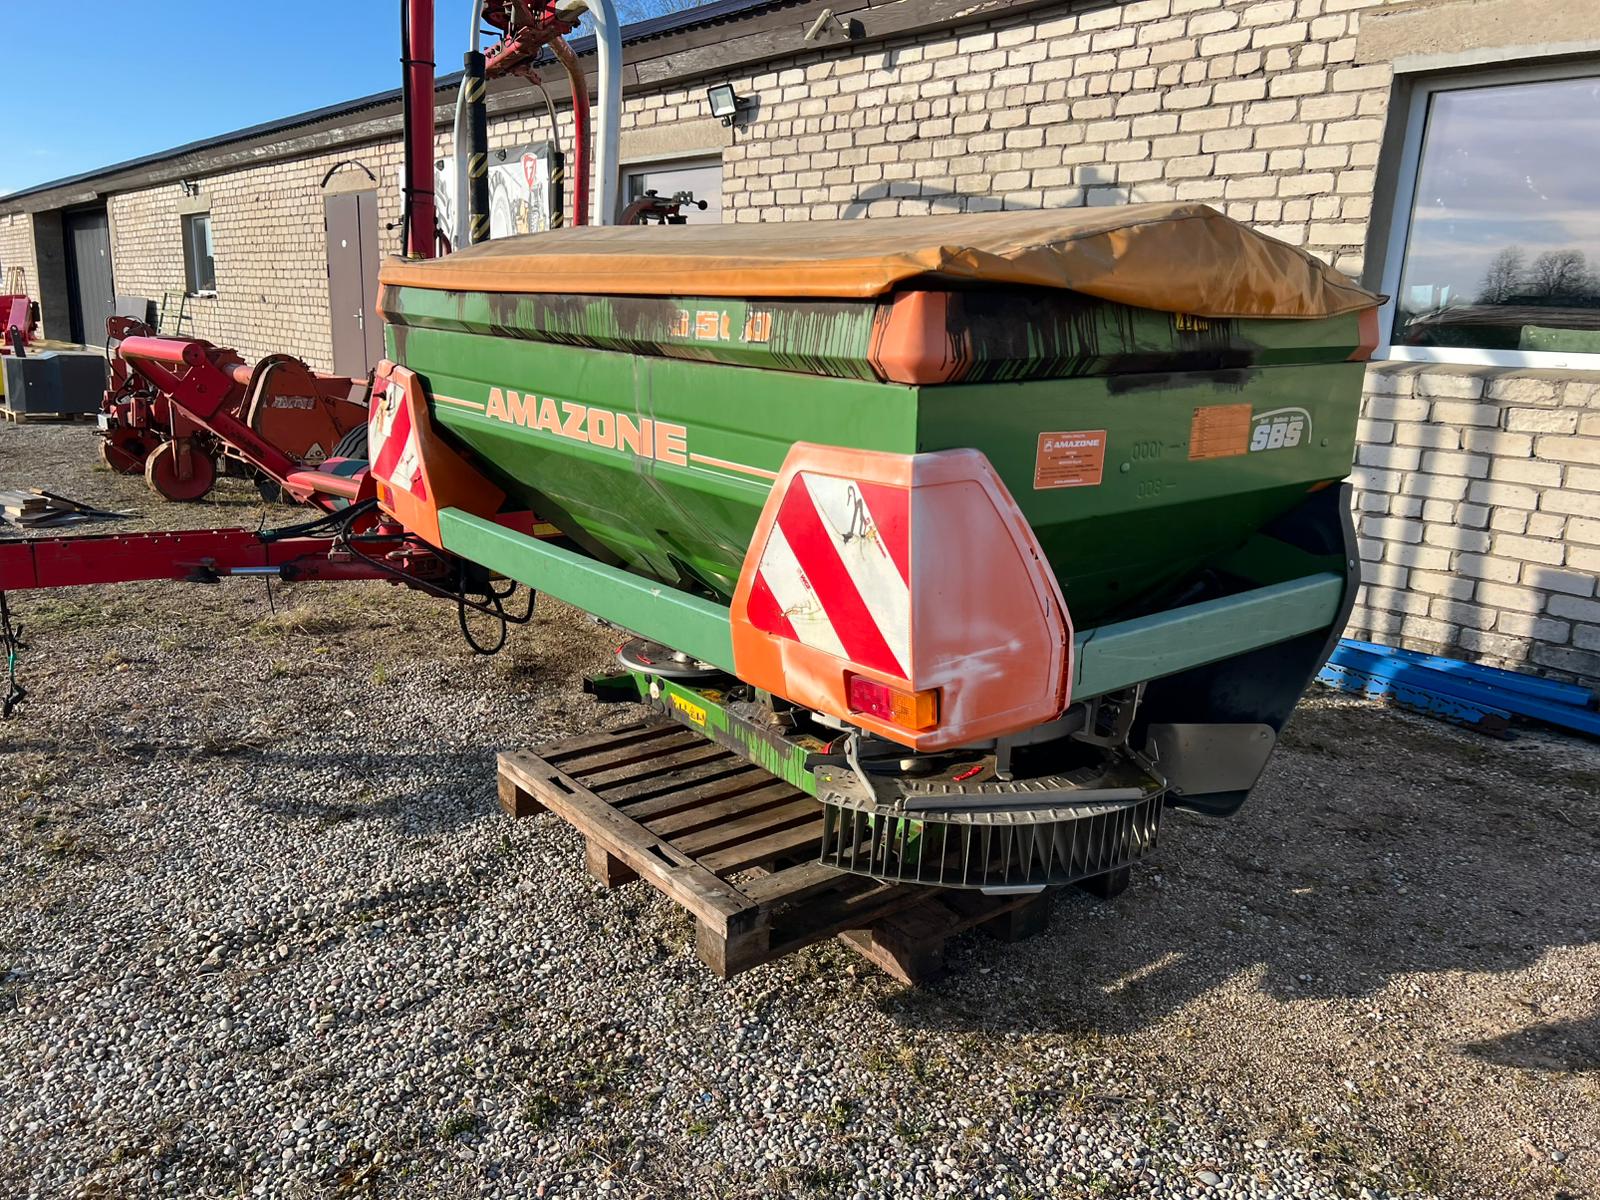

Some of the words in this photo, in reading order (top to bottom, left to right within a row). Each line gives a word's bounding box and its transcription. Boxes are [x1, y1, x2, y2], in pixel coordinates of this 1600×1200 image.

[485, 387, 688, 467] AMAZONE
[1250, 421, 1303, 451] SBS
[1053, 440, 1100, 448] AMAZONE
